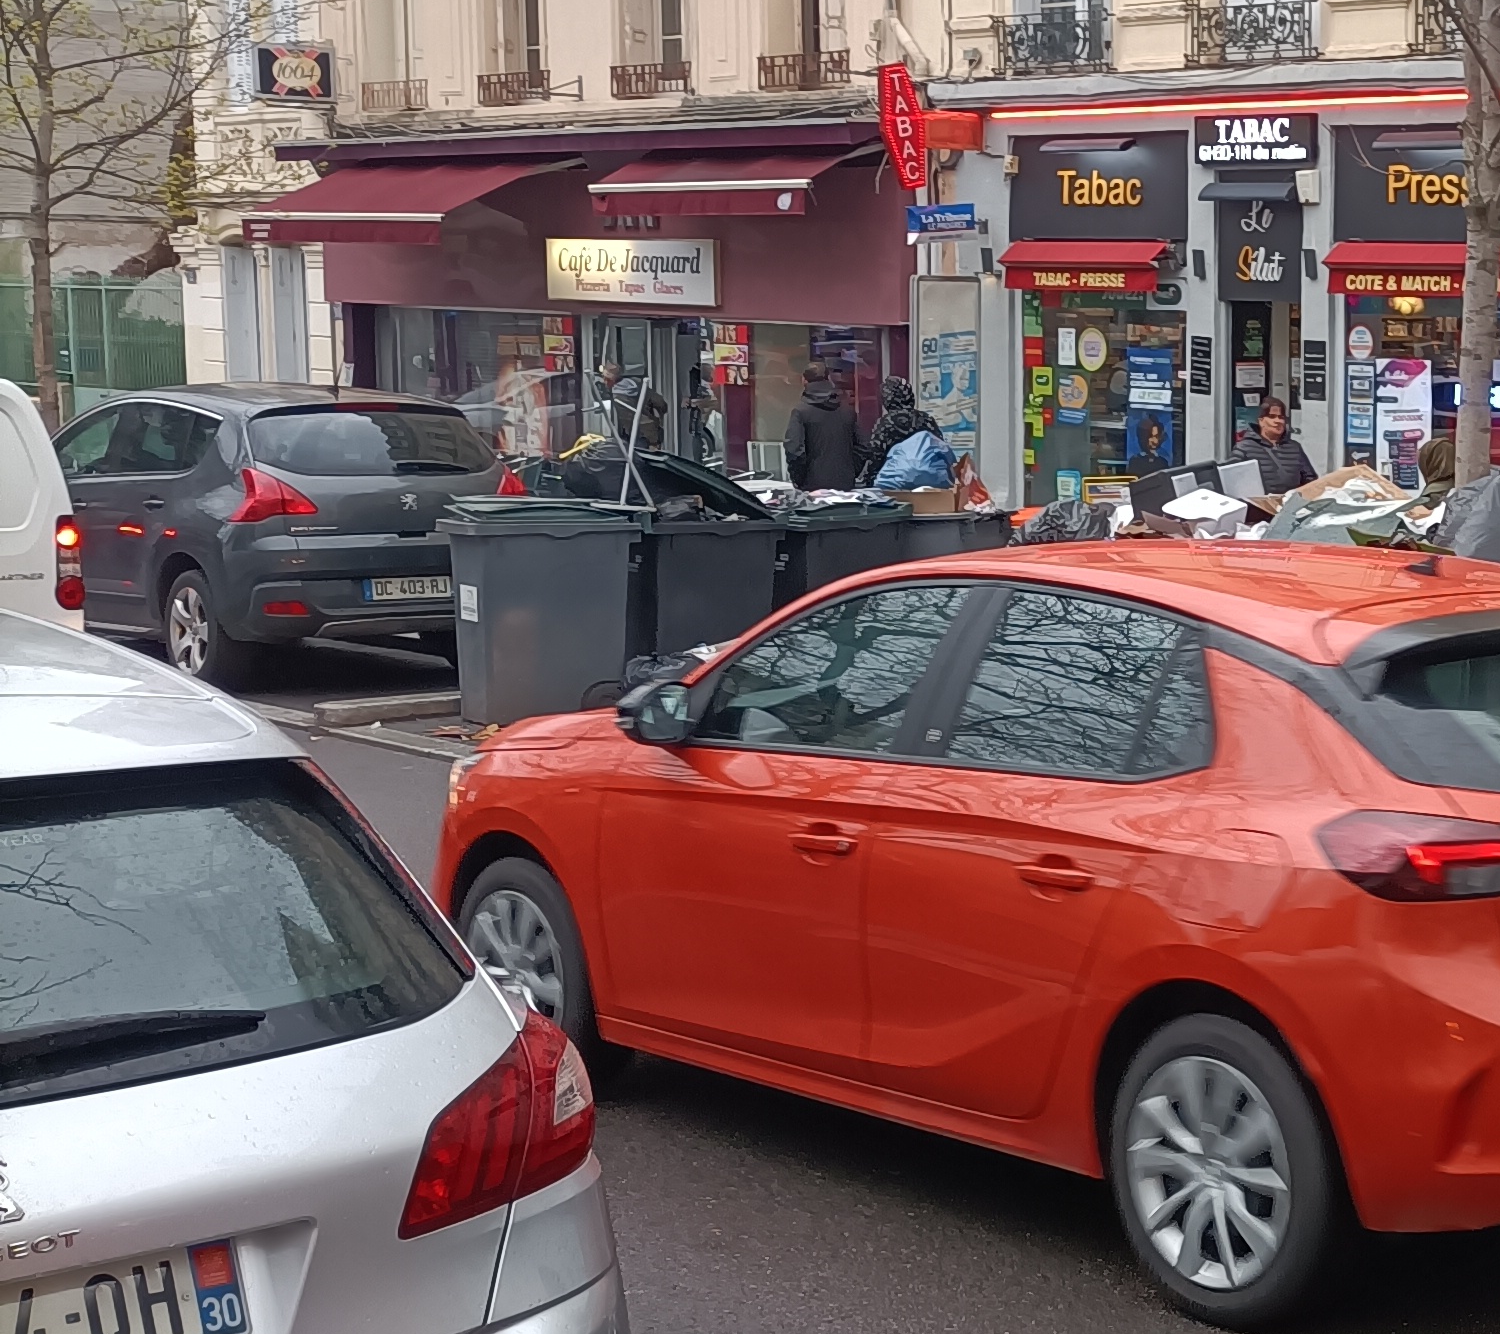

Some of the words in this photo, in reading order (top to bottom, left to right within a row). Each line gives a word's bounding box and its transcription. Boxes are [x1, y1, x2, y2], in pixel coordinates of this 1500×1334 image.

[276, 61, 318, 81] 1664
[890, 73, 920, 180] TABAC
[1215, 118, 1290, 143] TABAC
[1056, 169, 1142, 206] Tabac
[1387, 165, 1469, 204] Press
[558, 247, 592, 278] Café
[597, 248, 617, 273] De
[620, 247, 701, 280] Jacquard
[1033, 271, 1071, 286] TABAC
[1080, 272, 1125, 287] PRESSE
[1346, 275, 1383, 291] COTE
[1386, 275, 1397, 291] &
[1401, 275, 1451, 291] MATCH
[374, 578, 448, 597] DC-403-AJ
[201, 1292, 242, 1332] 30
